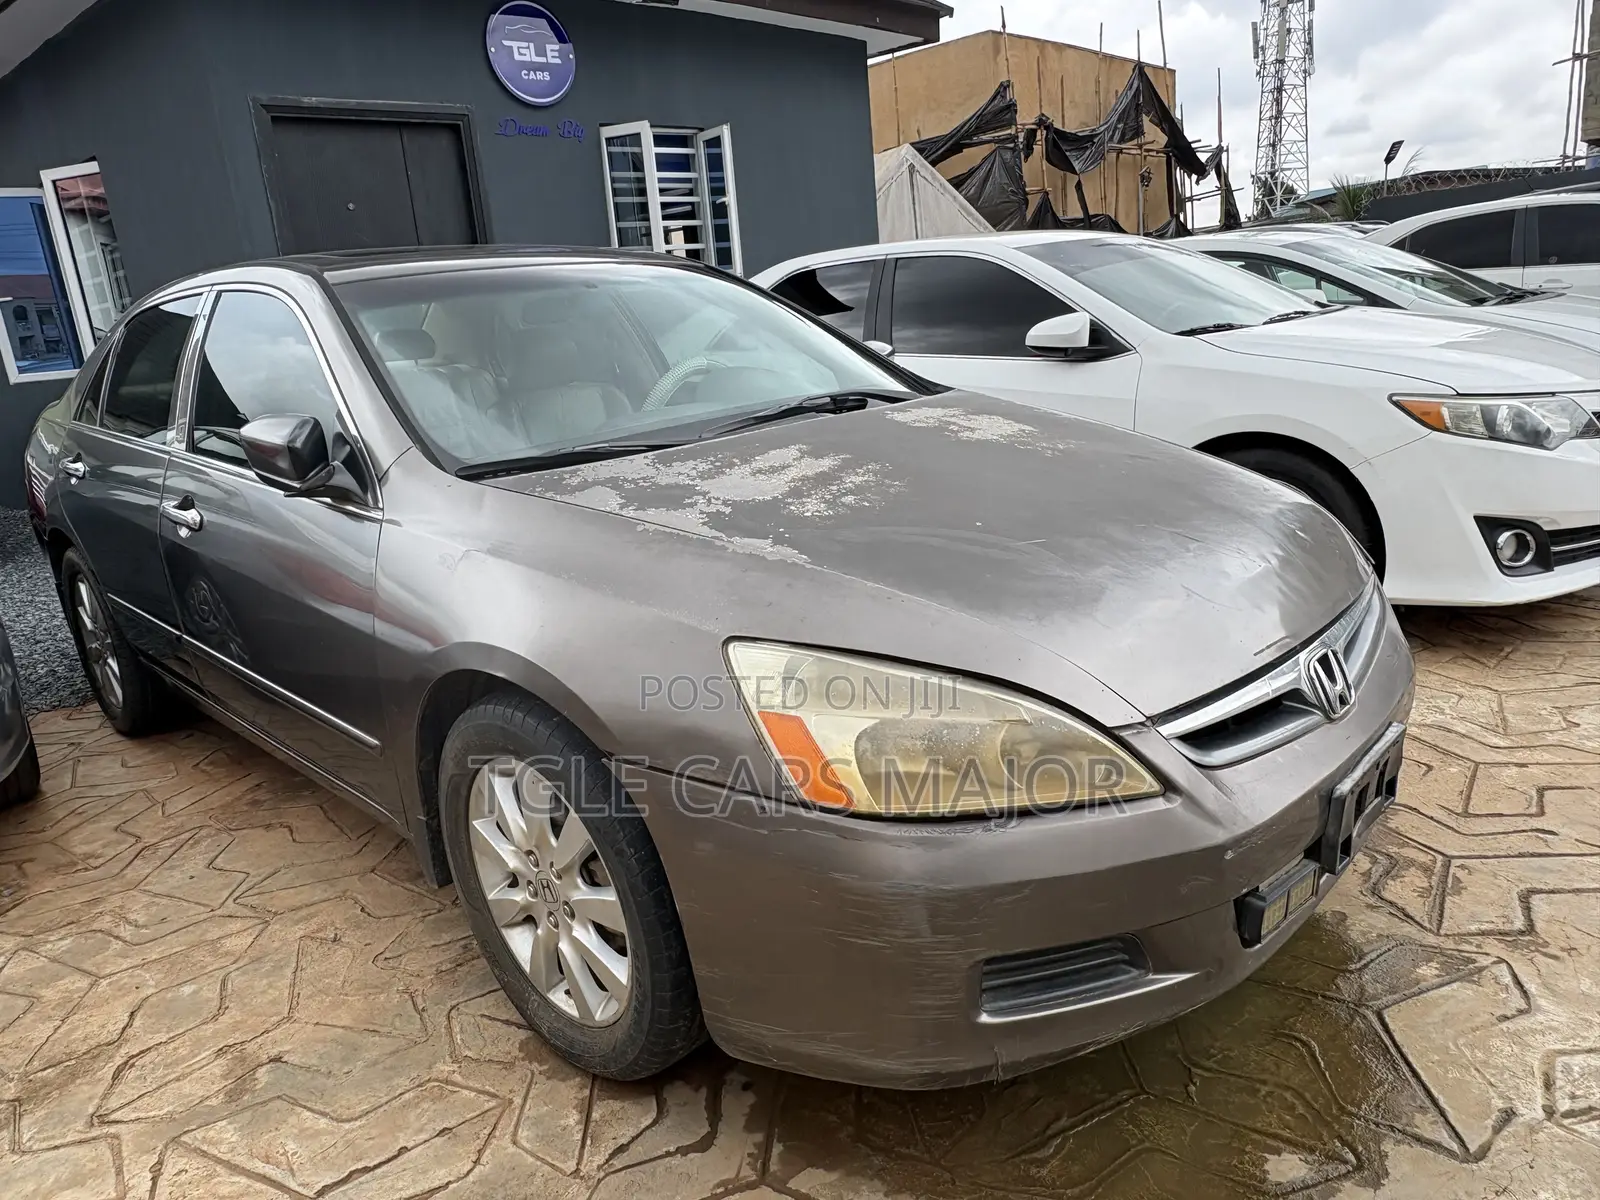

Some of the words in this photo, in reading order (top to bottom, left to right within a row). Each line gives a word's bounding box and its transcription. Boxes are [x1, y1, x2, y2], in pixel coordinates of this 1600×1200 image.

[501, 39, 562, 64] TGLE
[521, 69, 550, 81] CARS
[494, 117, 550, 138] Dream
[556, 119, 585, 144] Big
